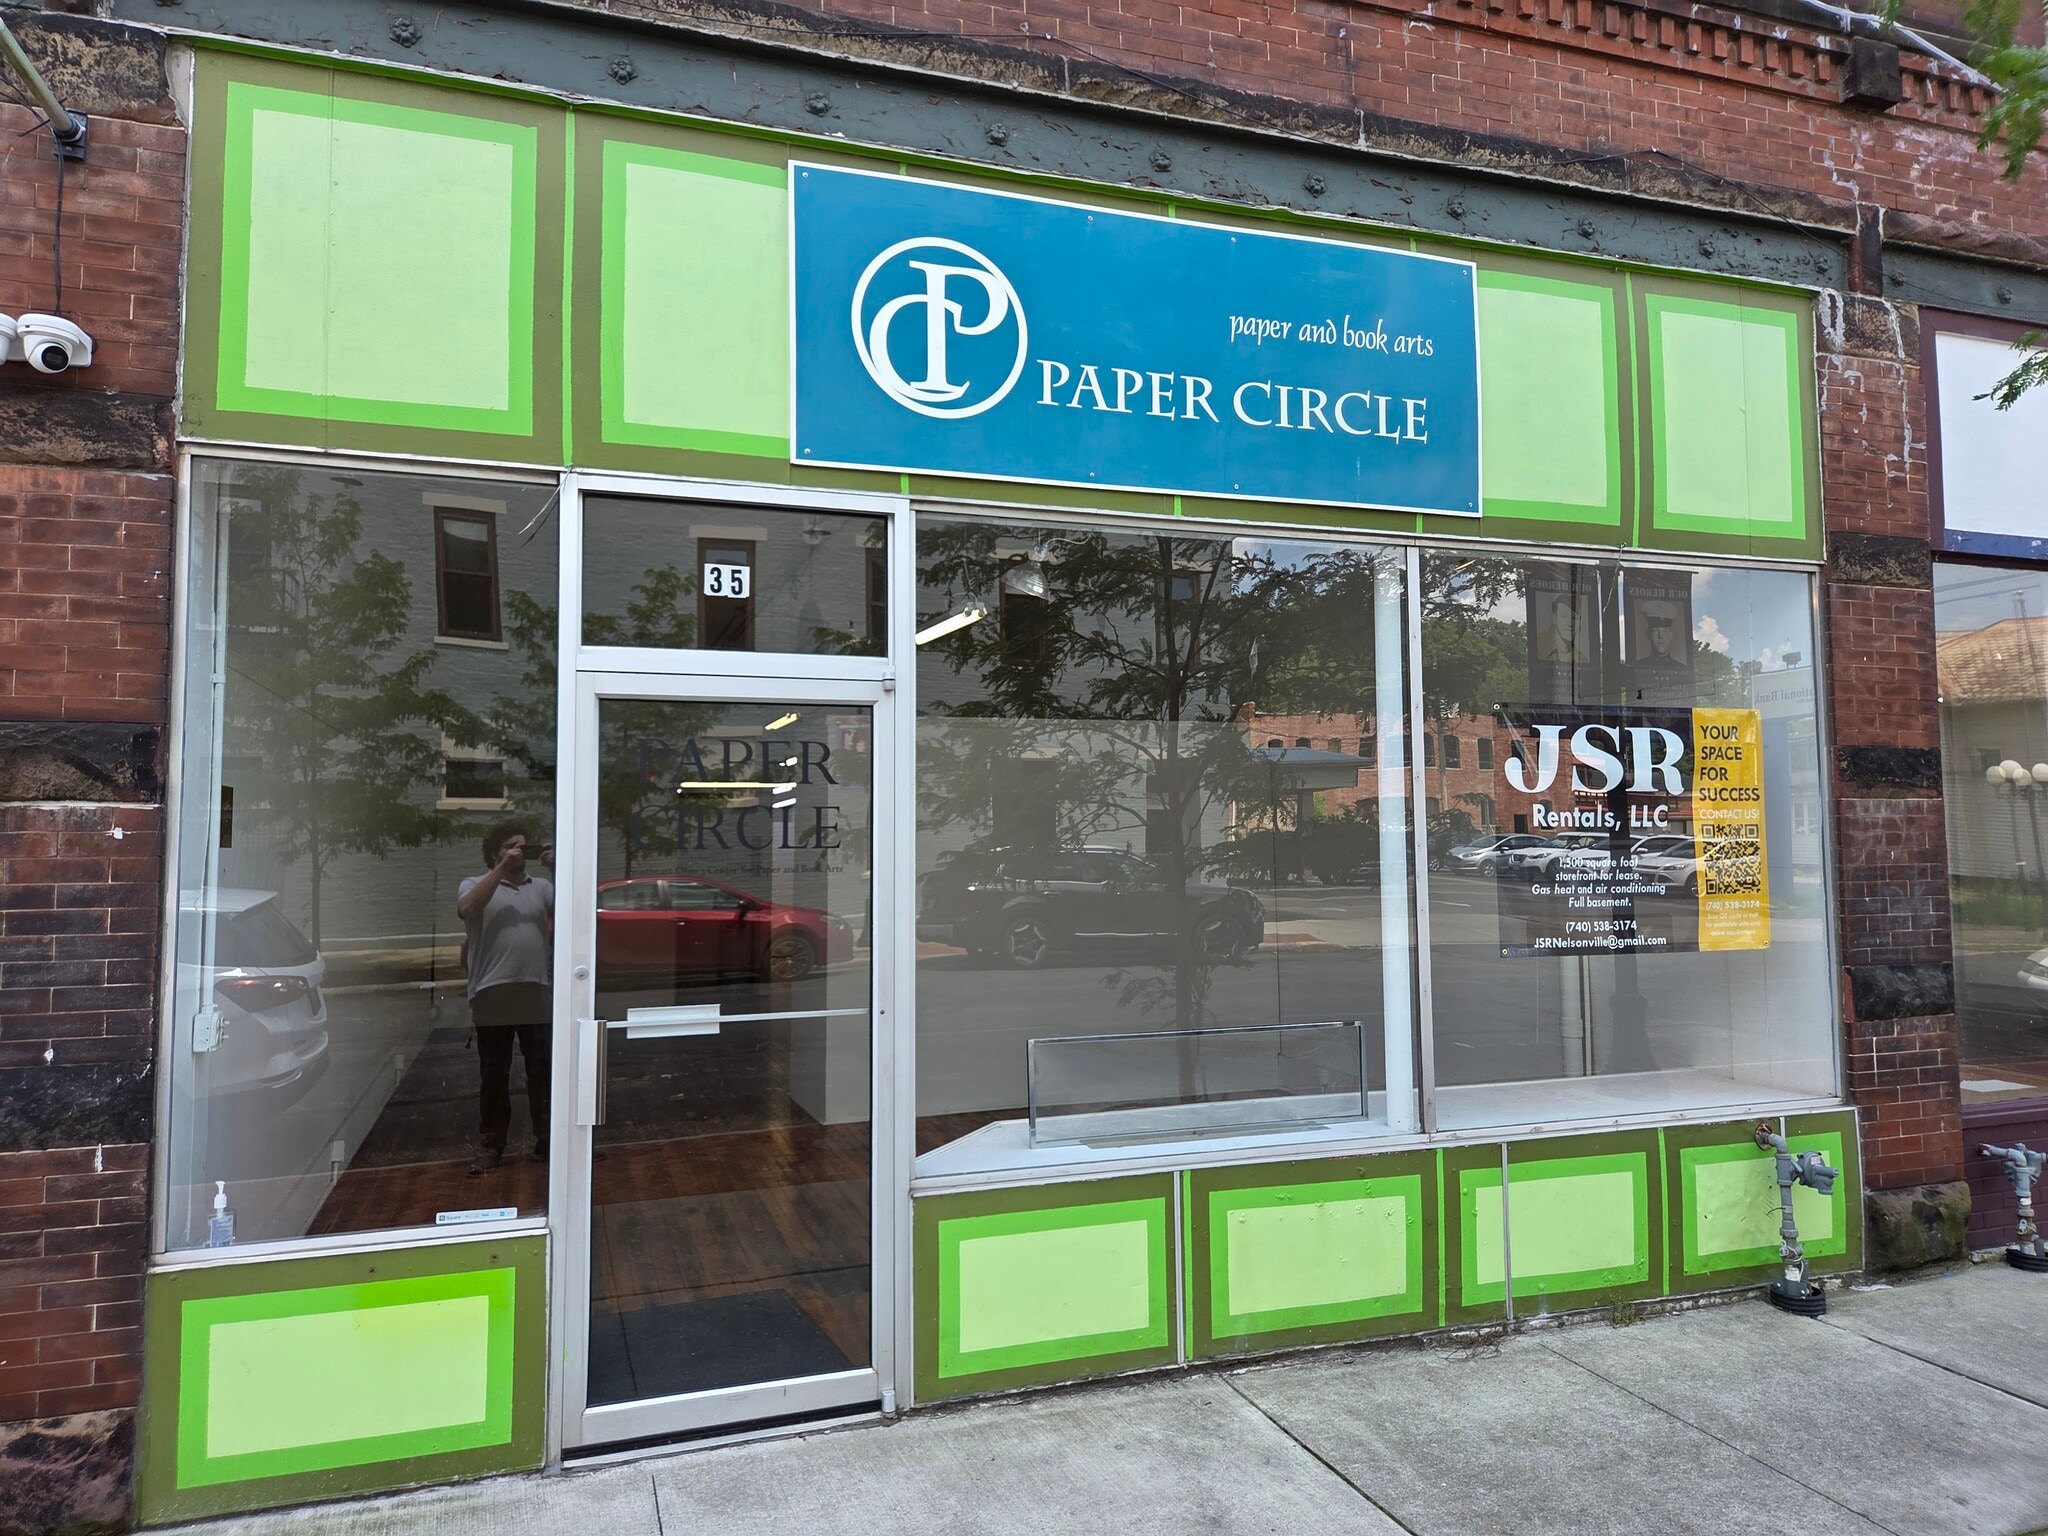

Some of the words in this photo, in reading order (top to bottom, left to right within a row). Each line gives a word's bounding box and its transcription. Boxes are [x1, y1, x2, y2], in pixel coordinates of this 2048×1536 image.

[1229, 315, 1292, 346] paper
[1298, 318, 1337, 345] and
[1343, 314, 1389, 355] book
[1394, 334, 1434, 356] arts
[1036, 359, 1220, 423] PAPER
[1232, 379, 1428, 445] CIRCLE
[709, 566, 744, 596] 35
[1699, 725, 1739, 740] YOUR
[1503, 723, 1685, 797] JSR
[1701, 745, 1743, 761] SPACE
[634, 738, 840, 786] PAPER
[1699, 766, 1729, 781] FOR
[1698, 787, 1760, 802] SUCCESS
[1532, 803, 1622, 832] Rentals,
[1630, 804, 1669, 828] LLC
[1699, 809, 1743, 819] CONTACT
[630, 803, 842, 851] CIRCLE
[755, 864, 781, 877] Paper
[783, 863, 799, 874] and
[826, 863, 844, 873] Arts
[1559, 856, 1583, 869] 1,500
[1586, 857, 1617, 870] square
[1620, 856, 1639, 867] foot
[1555, 870, 1597, 881] storefront
[1600, 869, 1613, 881] for
[1615, 869, 1643, 880] lease.
[1531, 883, 1551, 895] Gas
[1554, 883, 1575, 895] heat
[1577, 883, 1593, 894] and
[1595, 883, 1608, 894] air
[1610, 882, 1666, 895] conditioning
[1568, 896, 1585, 908] Full
[1587, 896, 1632, 908] basement.
[1724, 900, 1760, 909] 538-3174
[1565, 920, 1592, 934] (740)
[1593, 920, 1638, 932] 538-3174
[1533, 935, 1667, 950] JSRNelsonville@gmail.com
